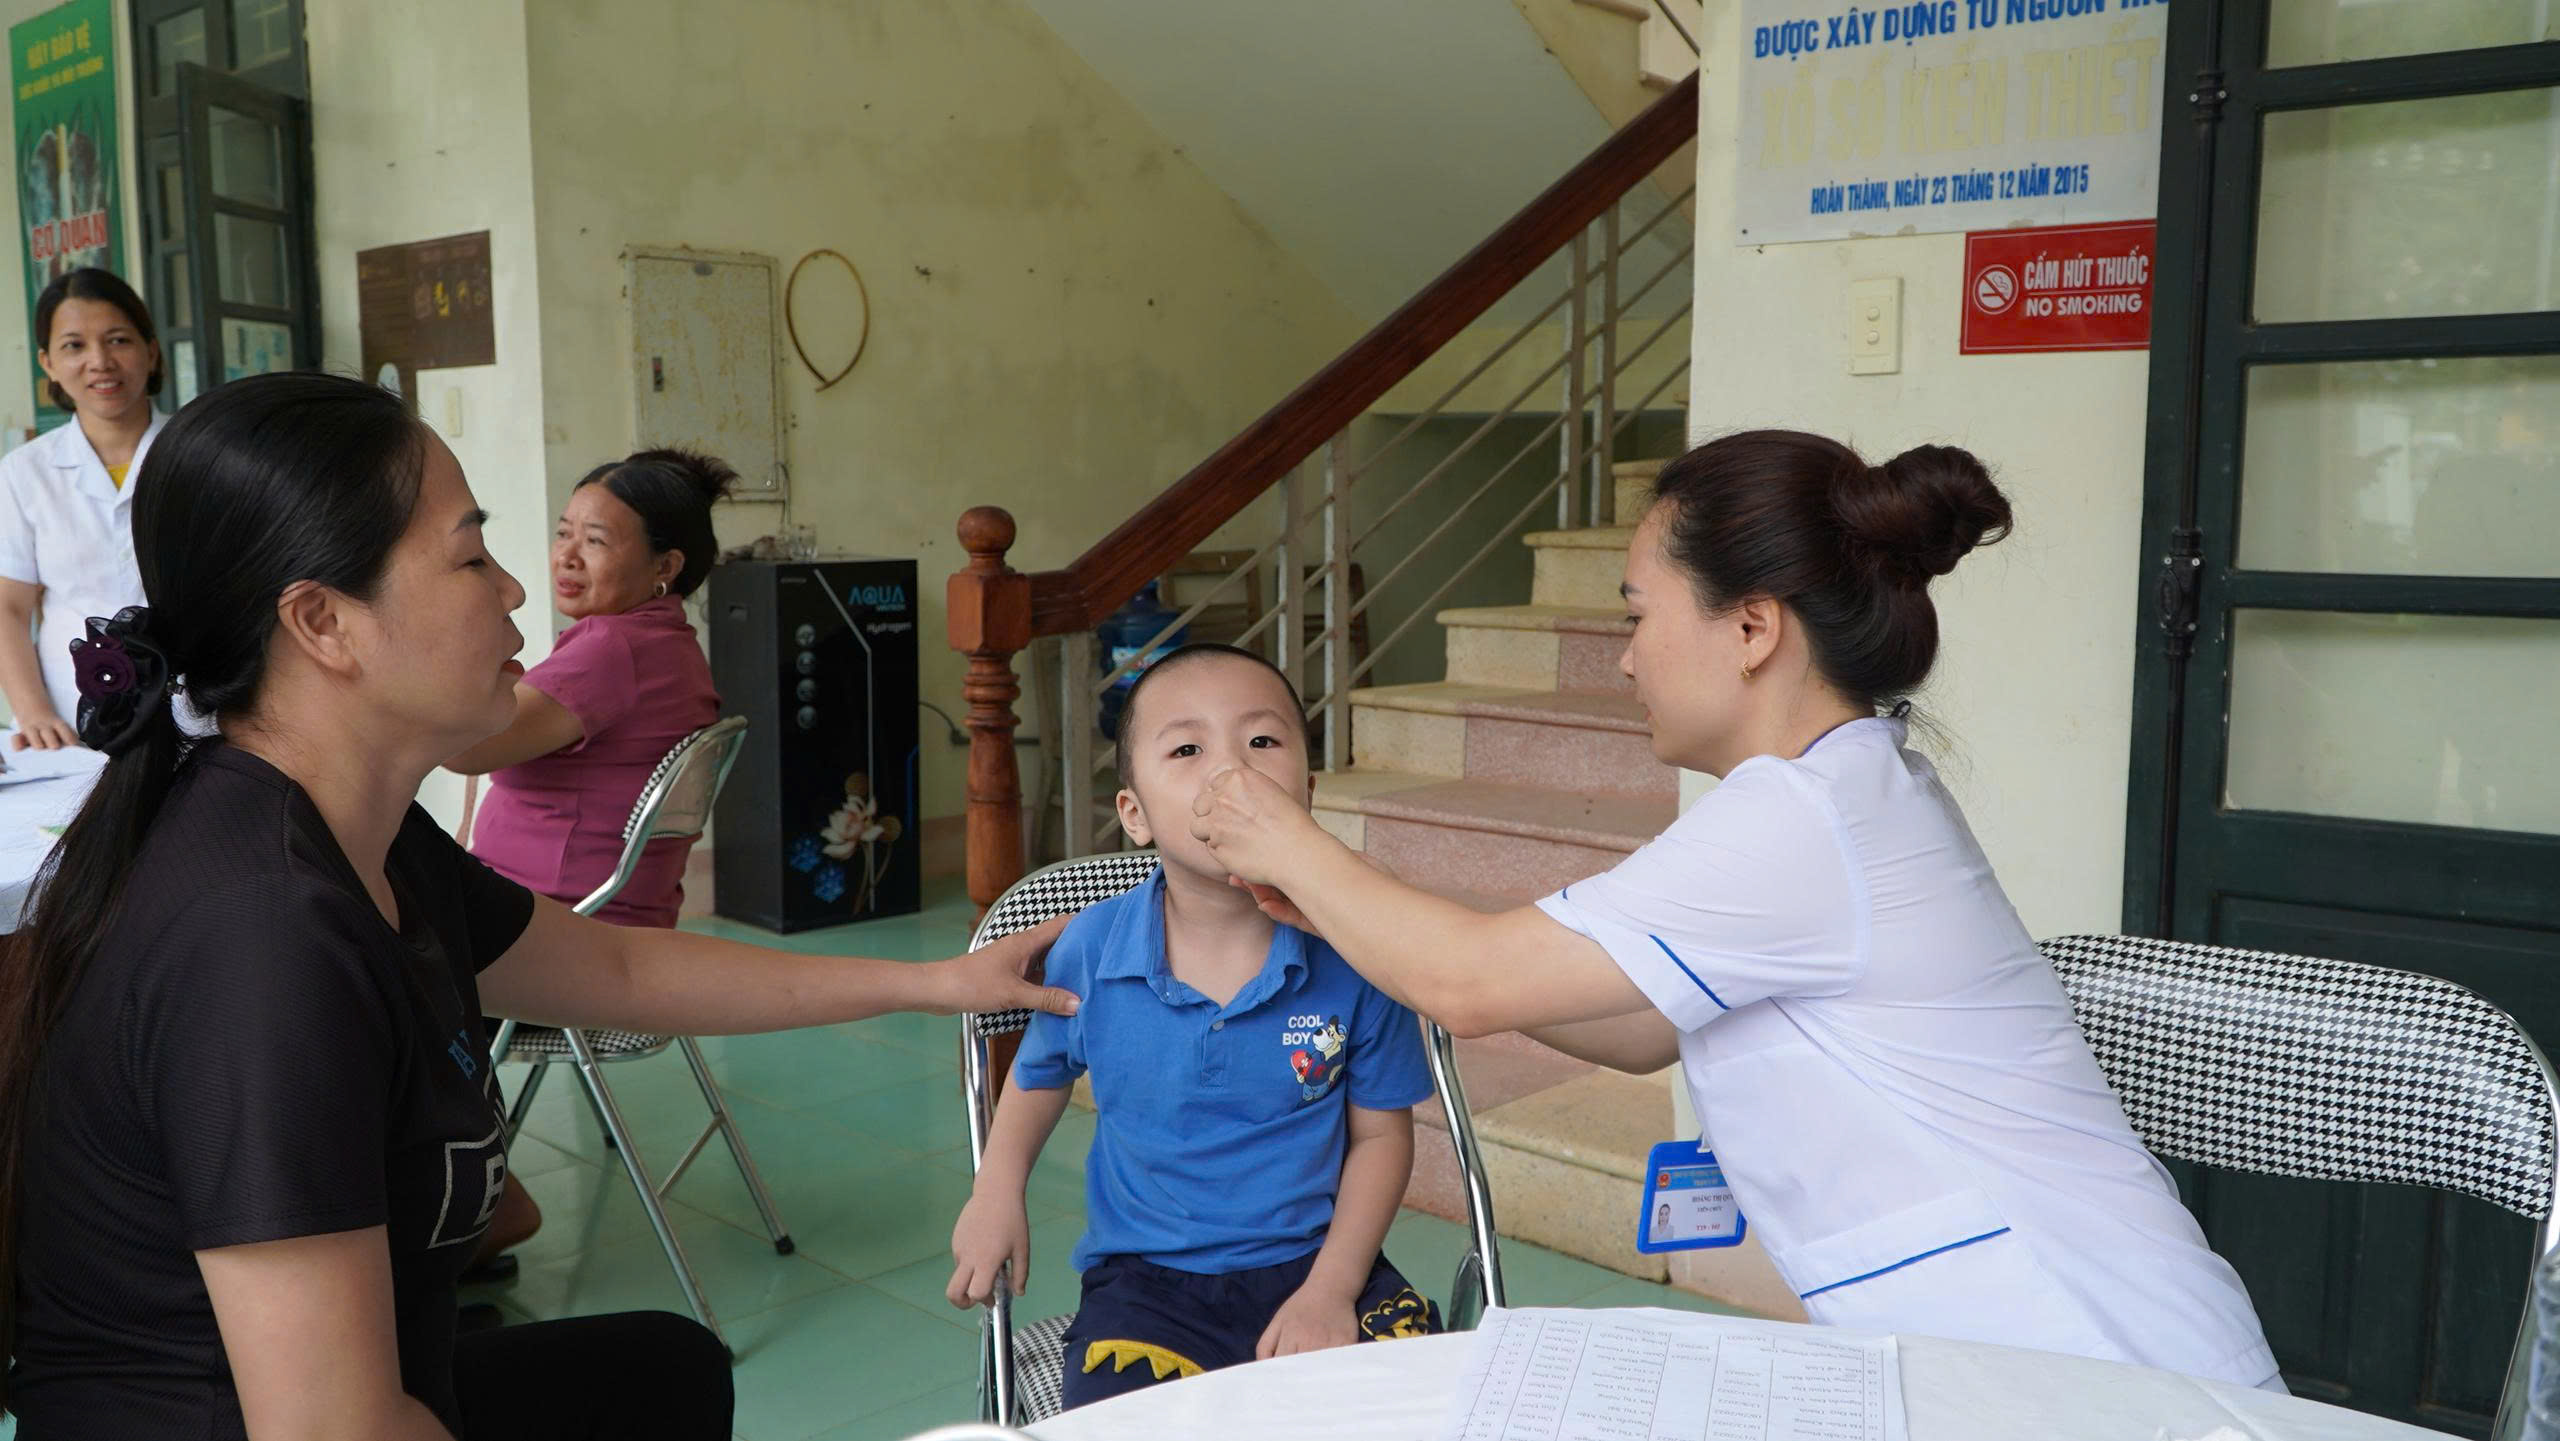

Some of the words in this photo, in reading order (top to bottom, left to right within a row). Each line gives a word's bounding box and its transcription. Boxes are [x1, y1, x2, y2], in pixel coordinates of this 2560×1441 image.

[1755, 20, 1819, 61] ĐƯỢC
[1826, 7, 1877, 49] XÂY
[1883, 1, 1957, 46] DỰNG
[1811, 180, 1845, 214] HOÀN
[1848, 177, 1890, 212] THÀNH,
[1894, 172, 1929, 207] NGÀY
[1931, 176, 1947, 204] 23
[1952, 168, 1994, 202] THÁNG
[2000, 171, 2015, 199] 12
[2018, 162, 2051, 198] NĂM
[2053, 164, 2089, 195] 2015
[2024, 250, 2060, 290] CẤM
[2063, 252, 2093, 288] HÚT
[2097, 245, 2149, 285] THUỐC
[2026, 297, 2053, 316] NO
[2057, 293, 2143, 315] SMOKING
[849, 586, 905, 606] AQUA
[1288, 1014, 1324, 1029] COOL
[1282, 1032, 1311, 1046] BOY
